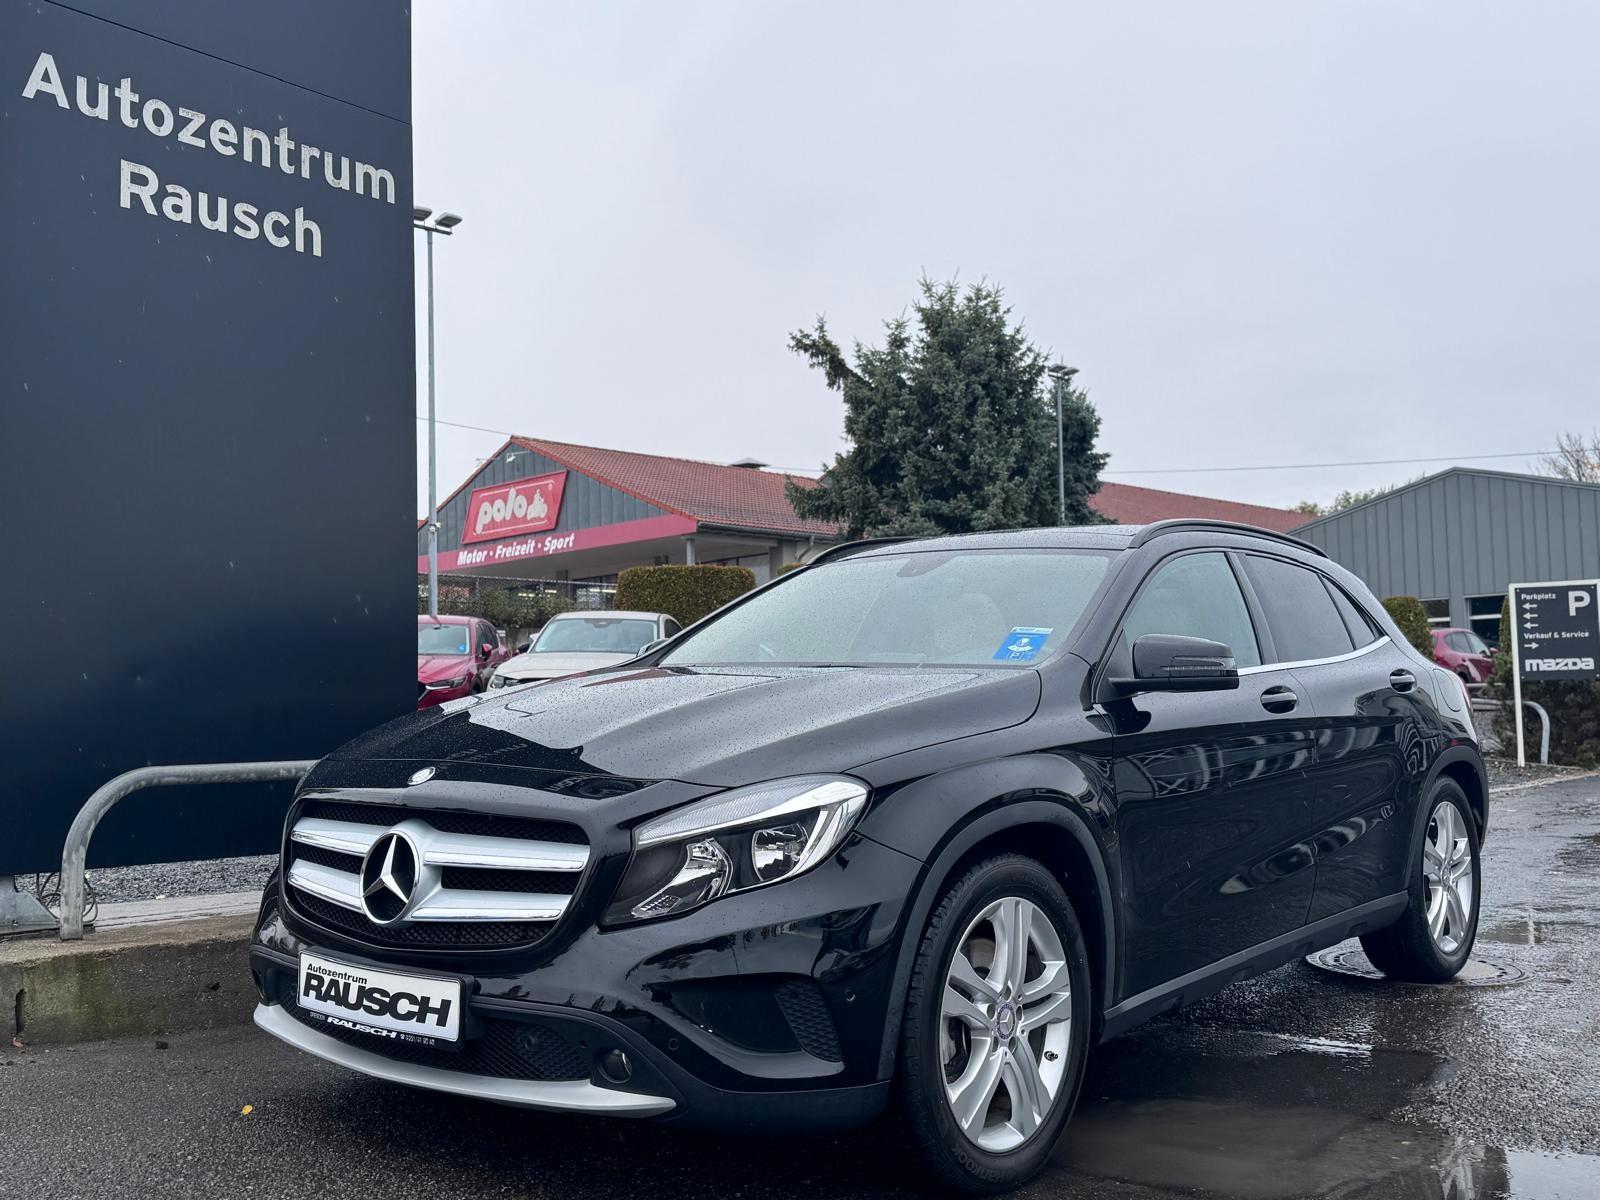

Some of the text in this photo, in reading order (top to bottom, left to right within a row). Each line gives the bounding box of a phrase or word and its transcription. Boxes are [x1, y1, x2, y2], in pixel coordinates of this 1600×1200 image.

[22, 52, 396, 204] Autozentrum
[119, 159, 322, 257] Rausch
[475, 487, 527, 534] polo
[457, 533, 575, 566] Motor Freizeit Sport
[1568, 591, 1590, 616] P
[1561, 630, 1589, 638] Service
[306, 963, 368, 985] Autozentrum
[303, 971, 452, 1028] RAUSCH
[327, 1016, 397, 1039] RAUSCH
